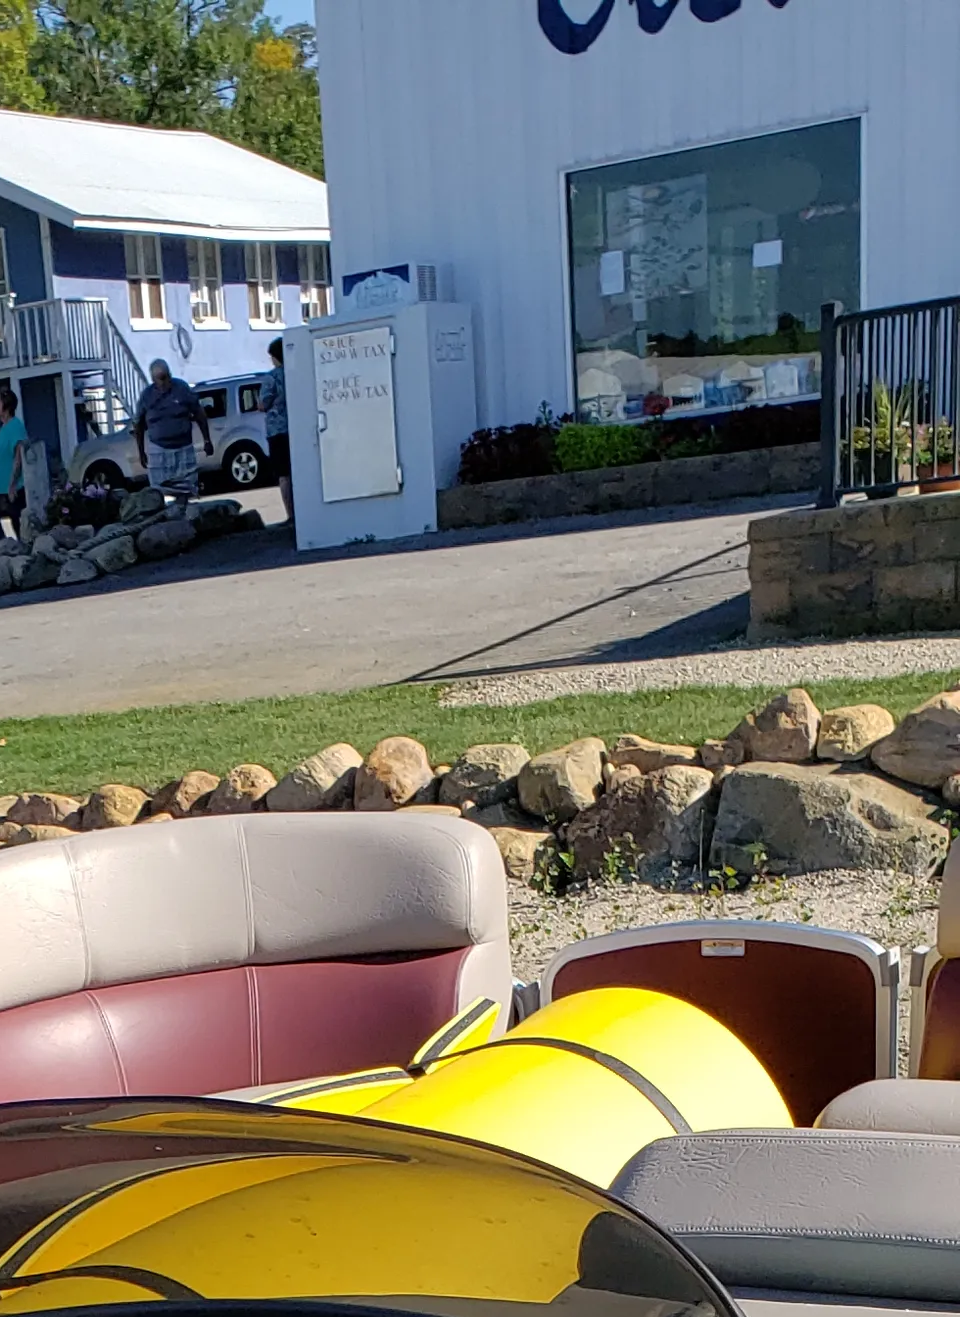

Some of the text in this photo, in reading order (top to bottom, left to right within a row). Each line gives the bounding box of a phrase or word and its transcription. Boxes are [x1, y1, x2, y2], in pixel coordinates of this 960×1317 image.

[337, 335, 355, 348] ICE
[363, 343, 386, 358] TAX
[341, 374, 361, 388] ICE
[365, 384, 389, 399] TAX
